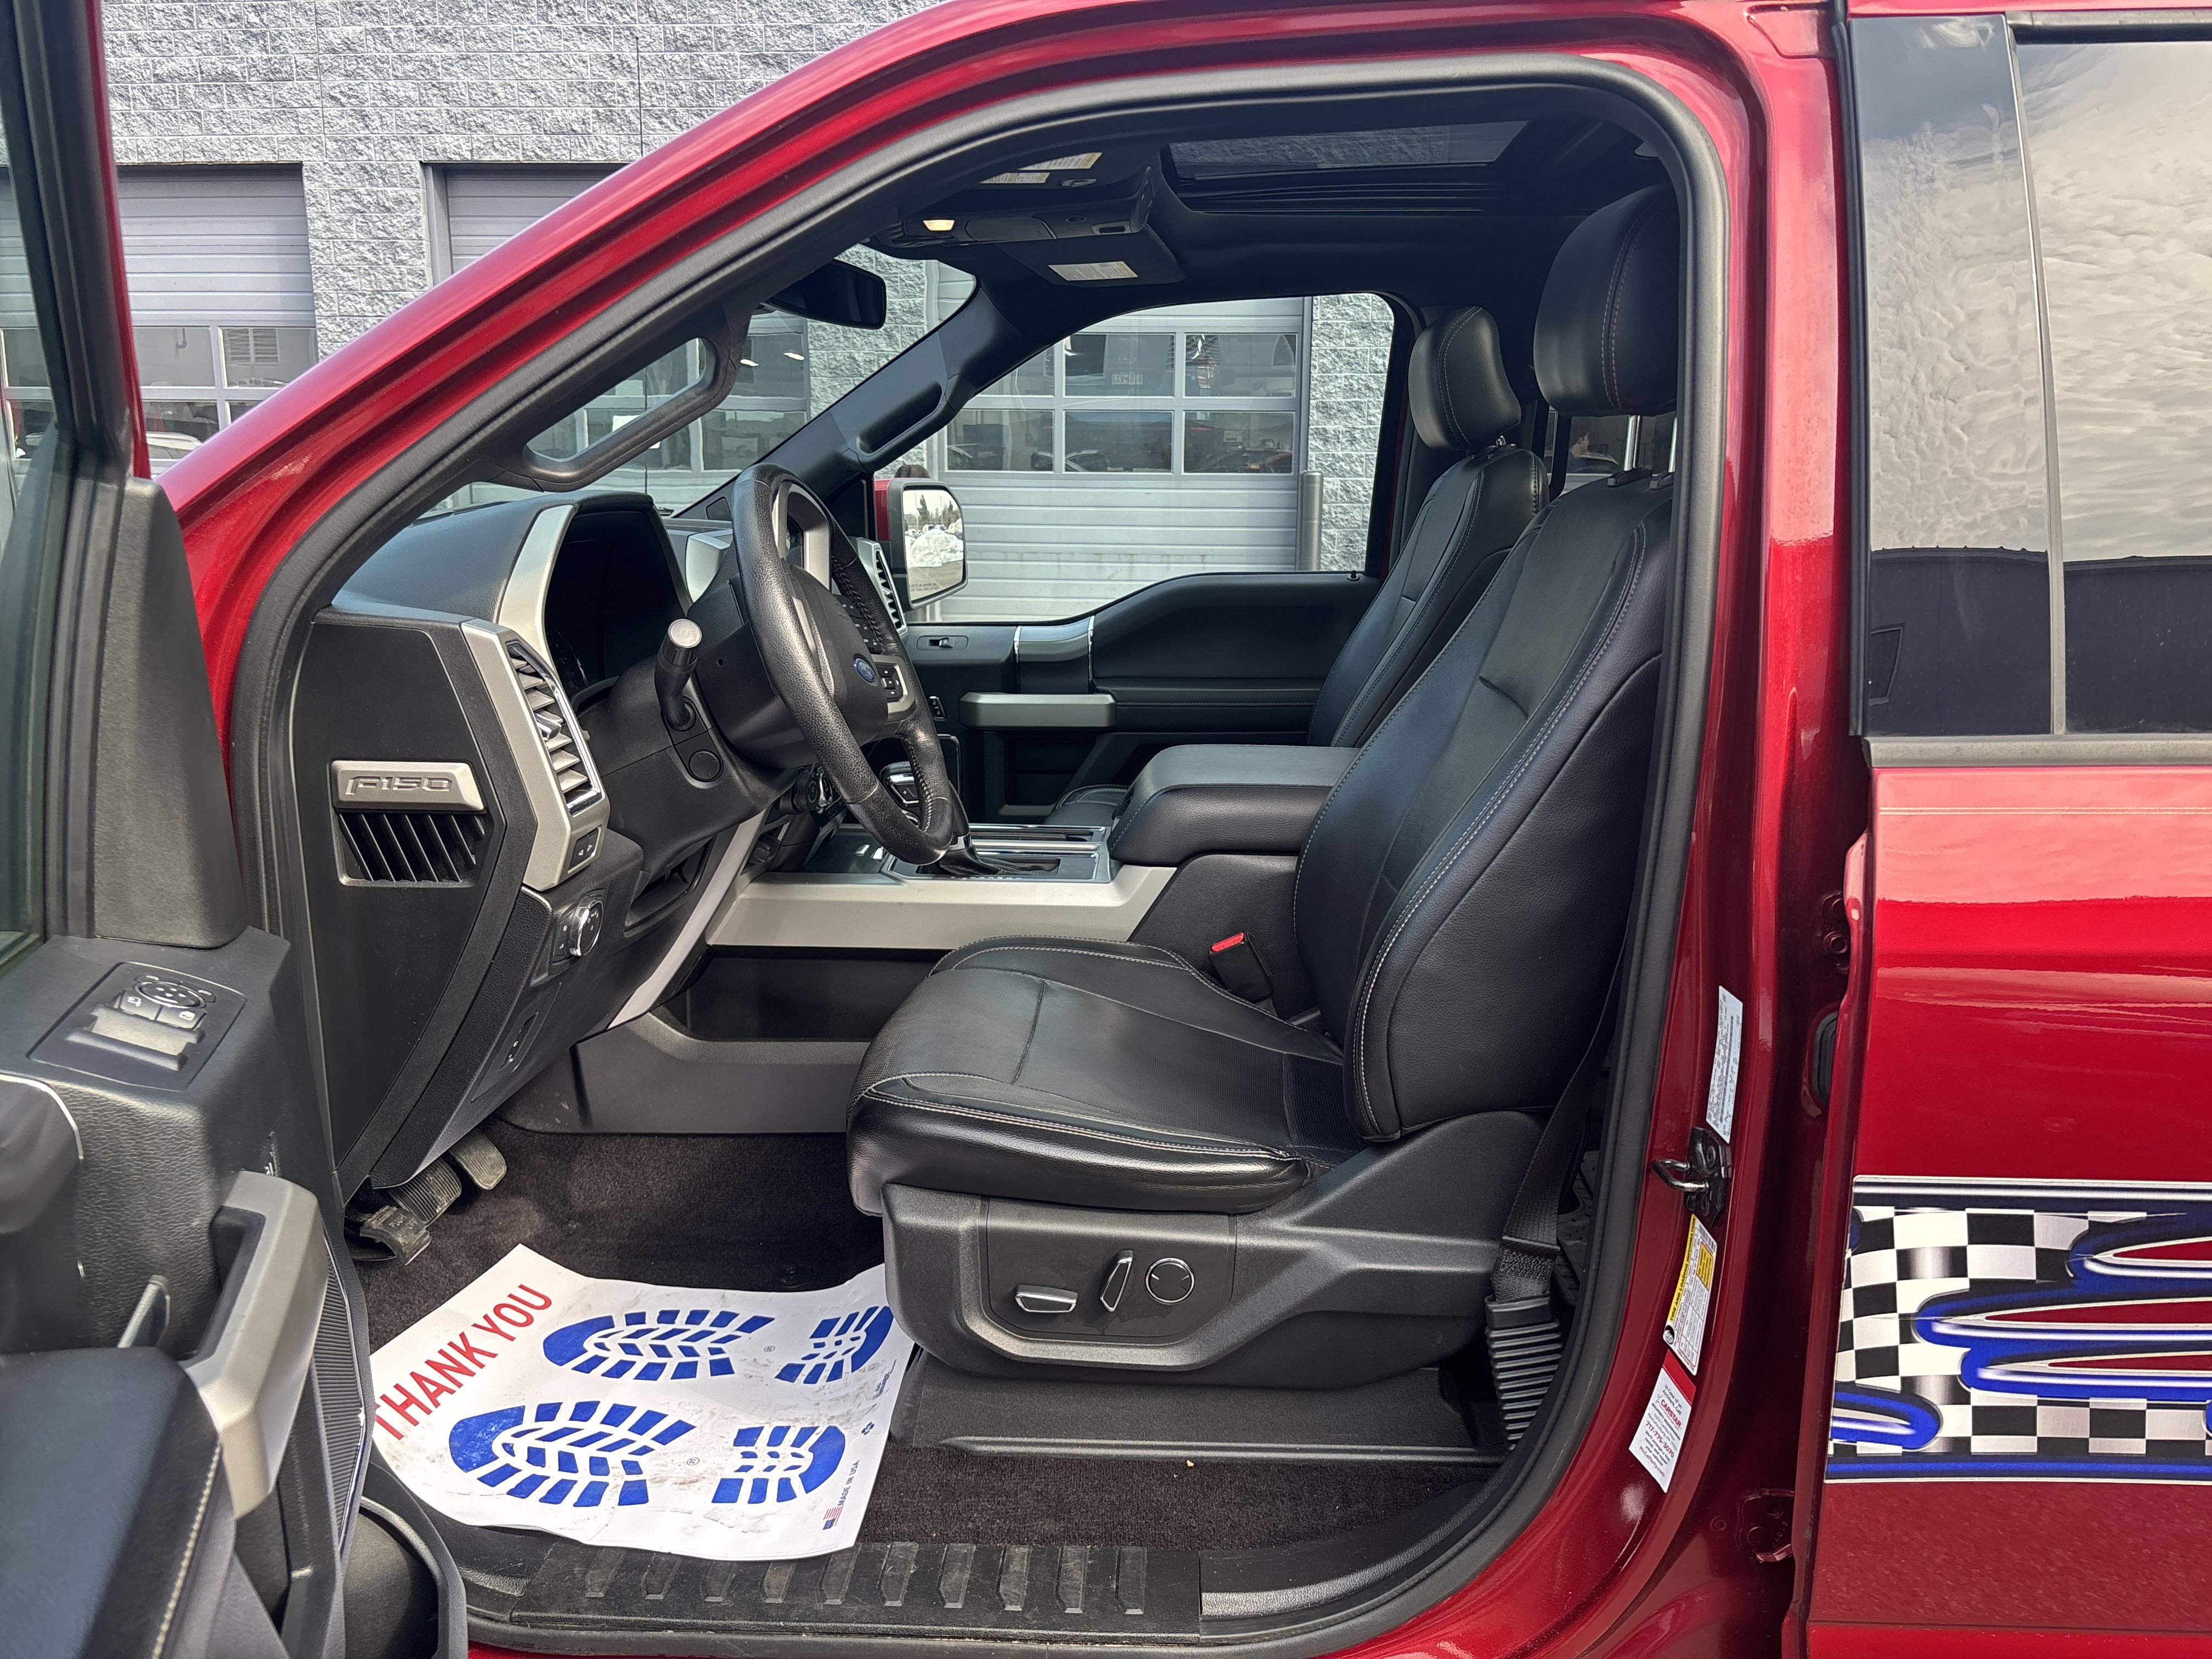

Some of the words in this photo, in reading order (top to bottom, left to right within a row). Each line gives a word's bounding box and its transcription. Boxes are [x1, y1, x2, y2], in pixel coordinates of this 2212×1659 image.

[1679, 1263, 1688, 1291] LOADING
[1686, 1217, 1696, 1262] INFORMATION
[374, 1330, 498, 1441] THANK
[473, 1283, 552, 1343] YOU
[1661, 1400, 1681, 1427] CARSTAR
[1646, 1420, 1674, 1458] 717-775-3070
[845, 1476, 854, 1485] IN
[849, 1460, 860, 1475] USA
[837, 1486, 850, 1506] MADE
